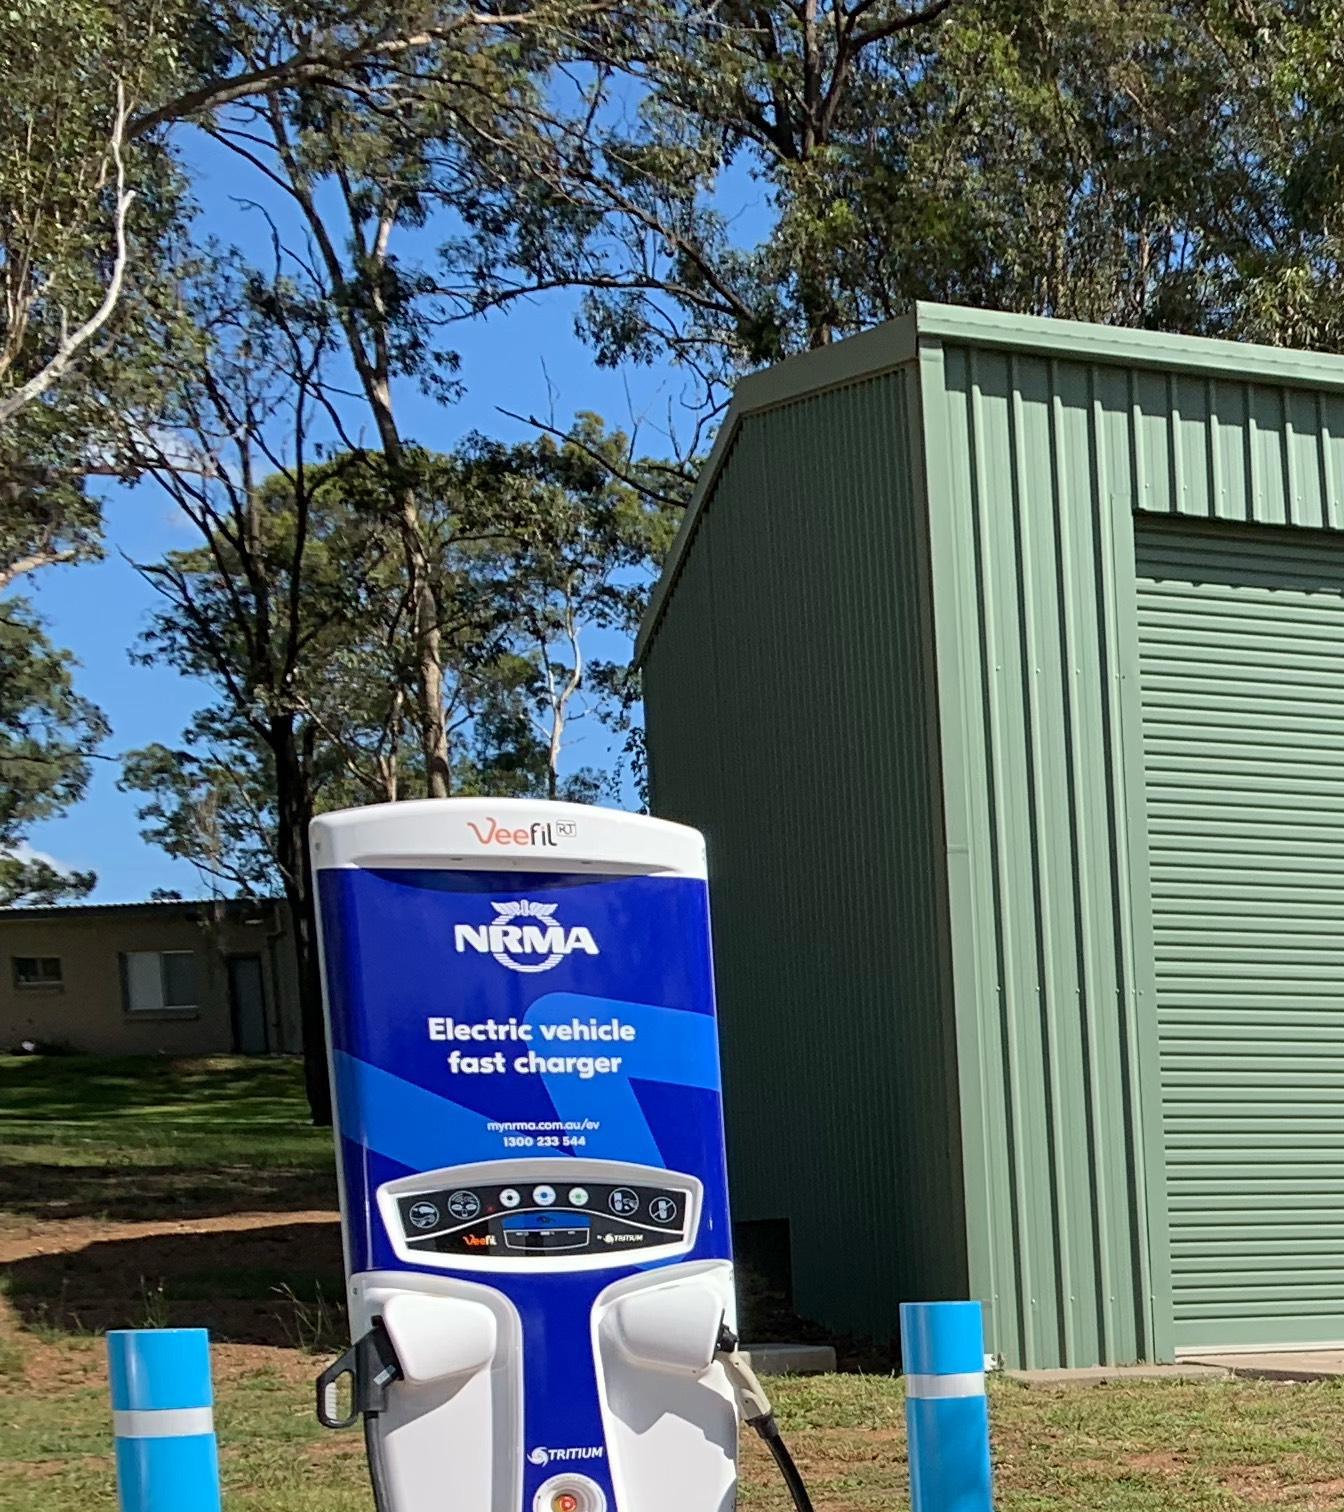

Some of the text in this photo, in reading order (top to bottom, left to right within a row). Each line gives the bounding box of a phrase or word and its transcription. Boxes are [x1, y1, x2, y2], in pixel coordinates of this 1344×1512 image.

[467, 816, 558, 847] Veefil
[454, 924, 599, 955] NRMA
[428, 1017, 636, 1041] Electric vehicle
[447, 1050, 622, 1079] fast charger
[487, 1118, 600, 1133] mynrma.com.au/ev
[503, 1136, 586, 1148] 1300 233 544
[548, 1446, 603, 1461] TRITIUM
